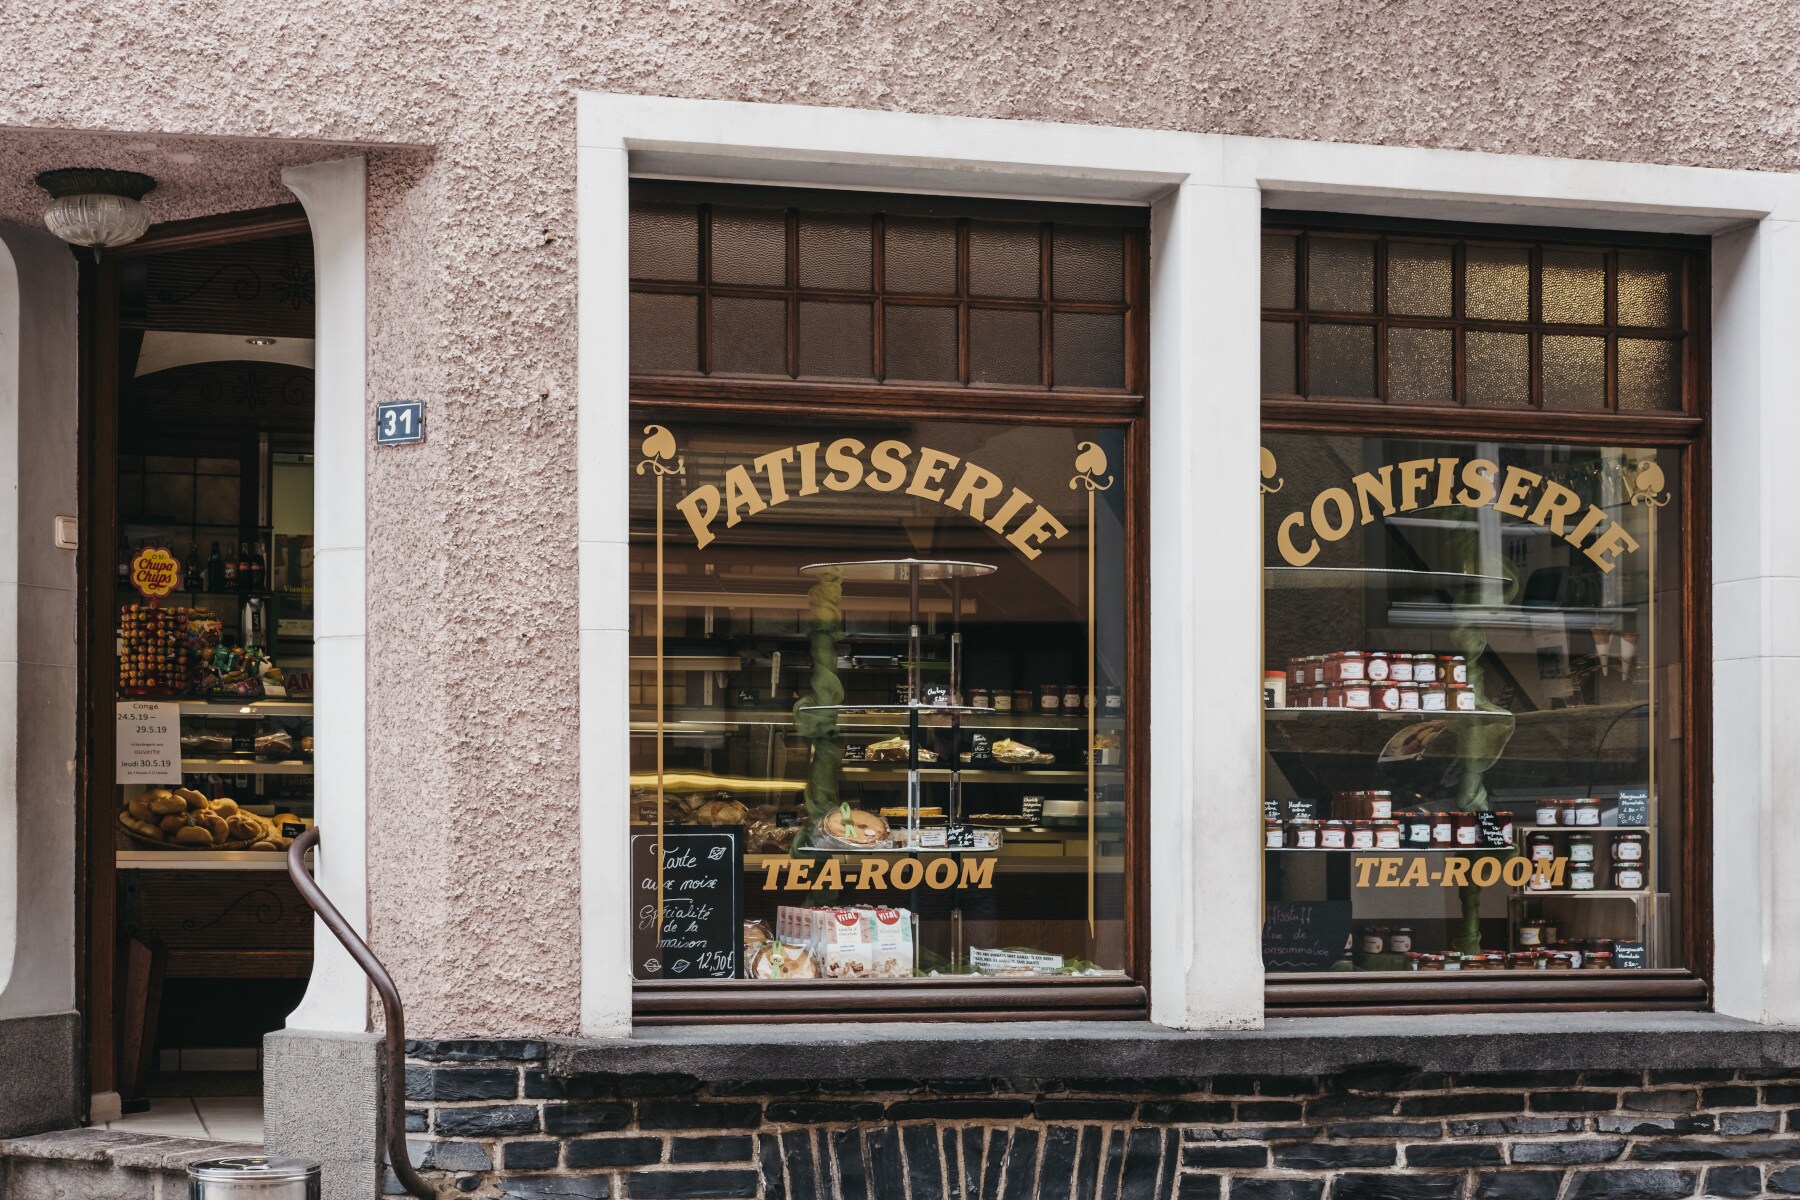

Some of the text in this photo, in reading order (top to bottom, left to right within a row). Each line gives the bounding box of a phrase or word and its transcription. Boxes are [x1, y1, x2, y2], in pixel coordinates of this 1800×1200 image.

[384, 409, 412, 436] 31
[676, 438, 1069, 560] PATISSERIE
[1277, 457, 1640, 574] CONFISERIE
[139, 558, 174, 574] Chupa
[136, 570, 172, 589] Chups
[133, 703, 159, 711] Congé
[117, 713, 149, 721] 24.5.19
[136, 726, 167, 734] 29.5.19
[140, 760, 171, 768] 30.5.19
[650, 843, 697, 870] Tarte
[761, 858, 997, 890] TEA-ROOM
[1355, 857, 1569, 888] TEA-ROOM
[680, 875, 718, 891] noix
[1266, 904, 1313, 925] ffisstuff
[663, 919, 699, 933] de la
[1293, 927, 1308, 940] de
[656, 937, 708, 949] maison
[1262, 940, 1330, 957] onsommation
